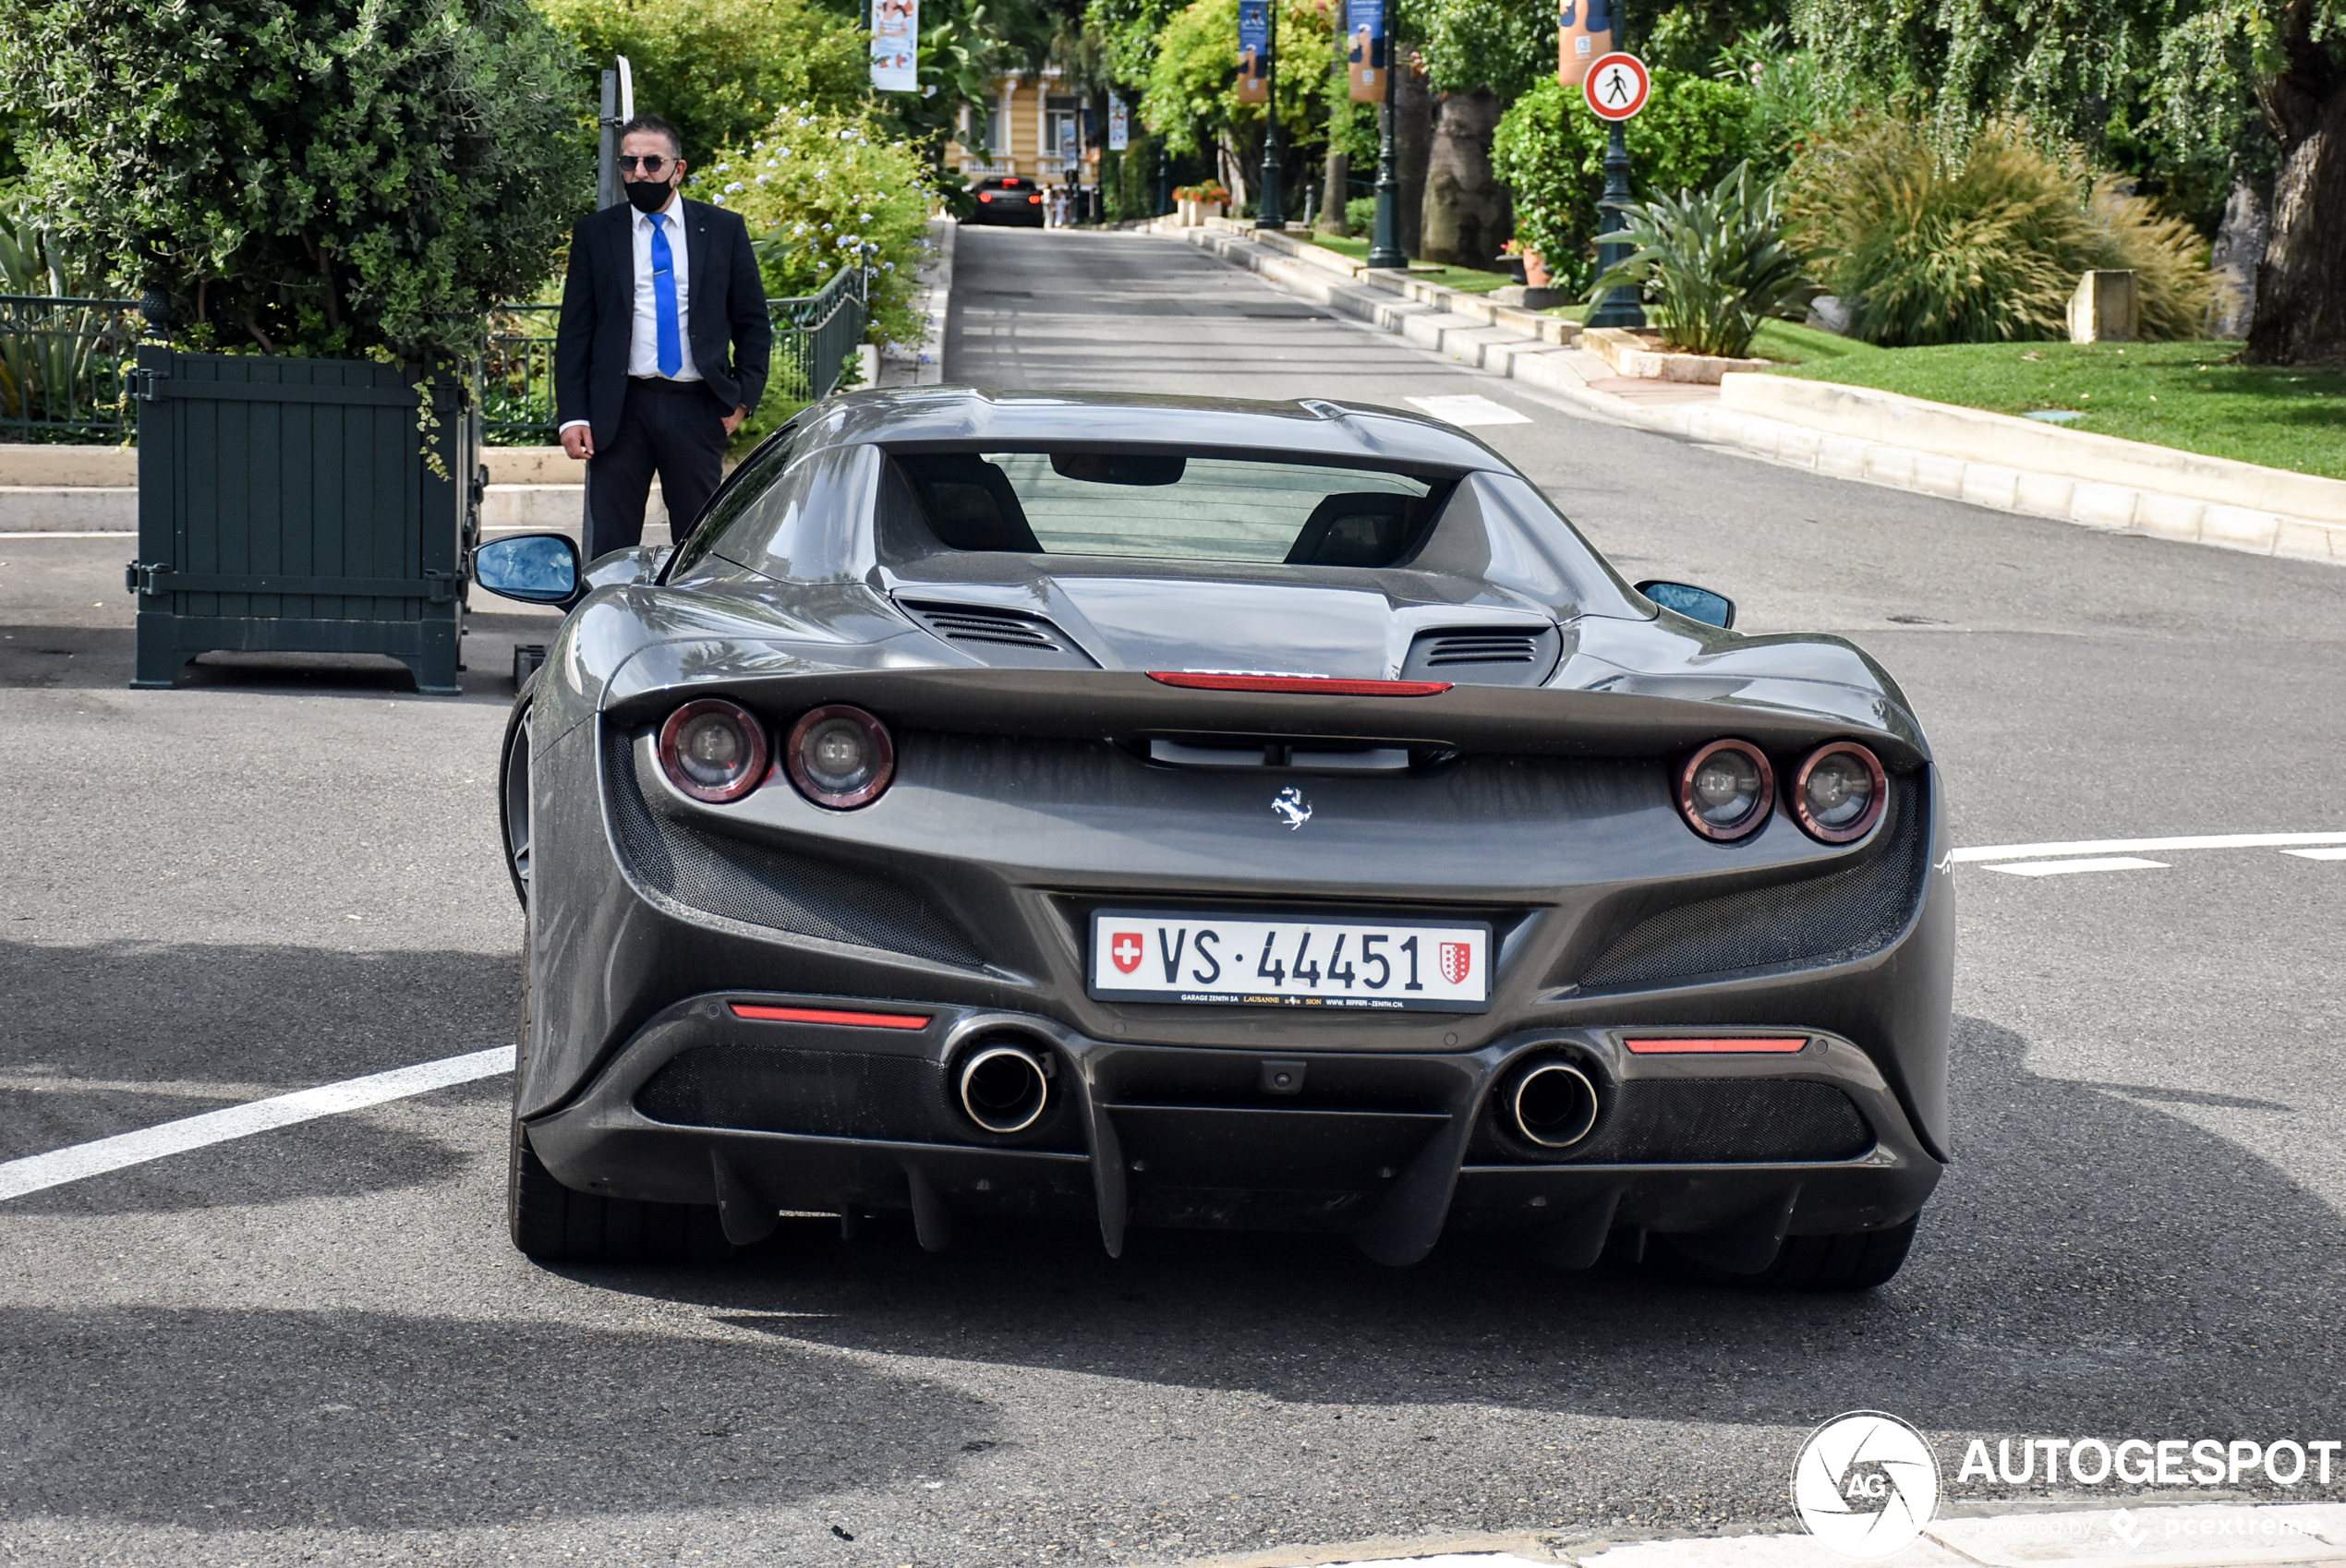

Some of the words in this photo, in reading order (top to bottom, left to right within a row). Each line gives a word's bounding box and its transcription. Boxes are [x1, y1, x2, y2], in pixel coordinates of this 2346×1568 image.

[1180, 994, 1208, 1002] GARAGE
[1208, 995, 1229, 1003] ZENITH
[1229, 995, 1239, 1003] SA
[1243, 995, 1280, 1004] LAUSANNE
